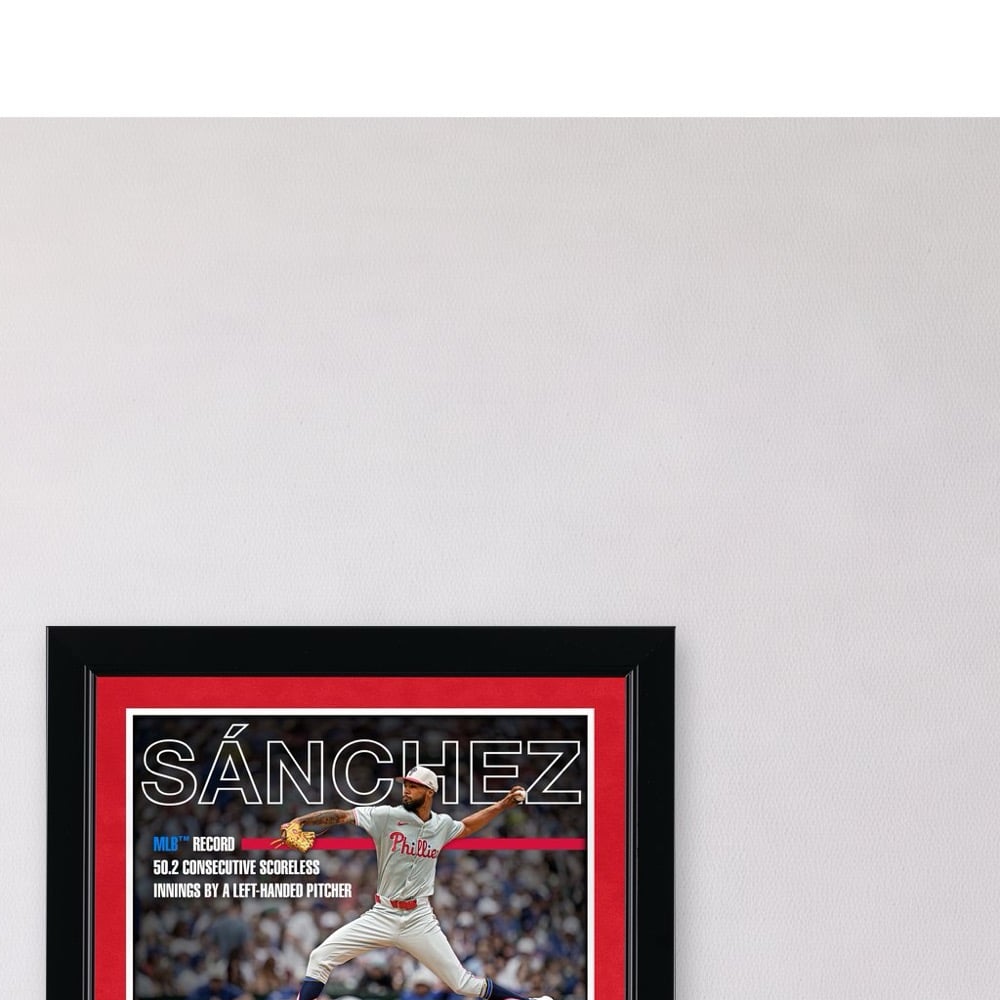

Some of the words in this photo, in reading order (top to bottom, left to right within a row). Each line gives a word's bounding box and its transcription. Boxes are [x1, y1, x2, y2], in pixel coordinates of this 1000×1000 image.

[141, 723, 582, 807] SÁNCHEZ
[192, 836, 235, 852] RECORD
[389, 831, 439, 859] Phillie
[153, 859, 179, 875] 50.2
[182, 859, 257, 875] CONSECUTIVE
[259, 859, 320, 875] SCORELESS
[153, 883, 201, 898] INNINGS
[204, 883, 219, 898] BY
[222, 883, 230, 898] A
[232, 883, 303, 898] LEFT-HANDED
[306, 883, 352, 898] PITCHER
